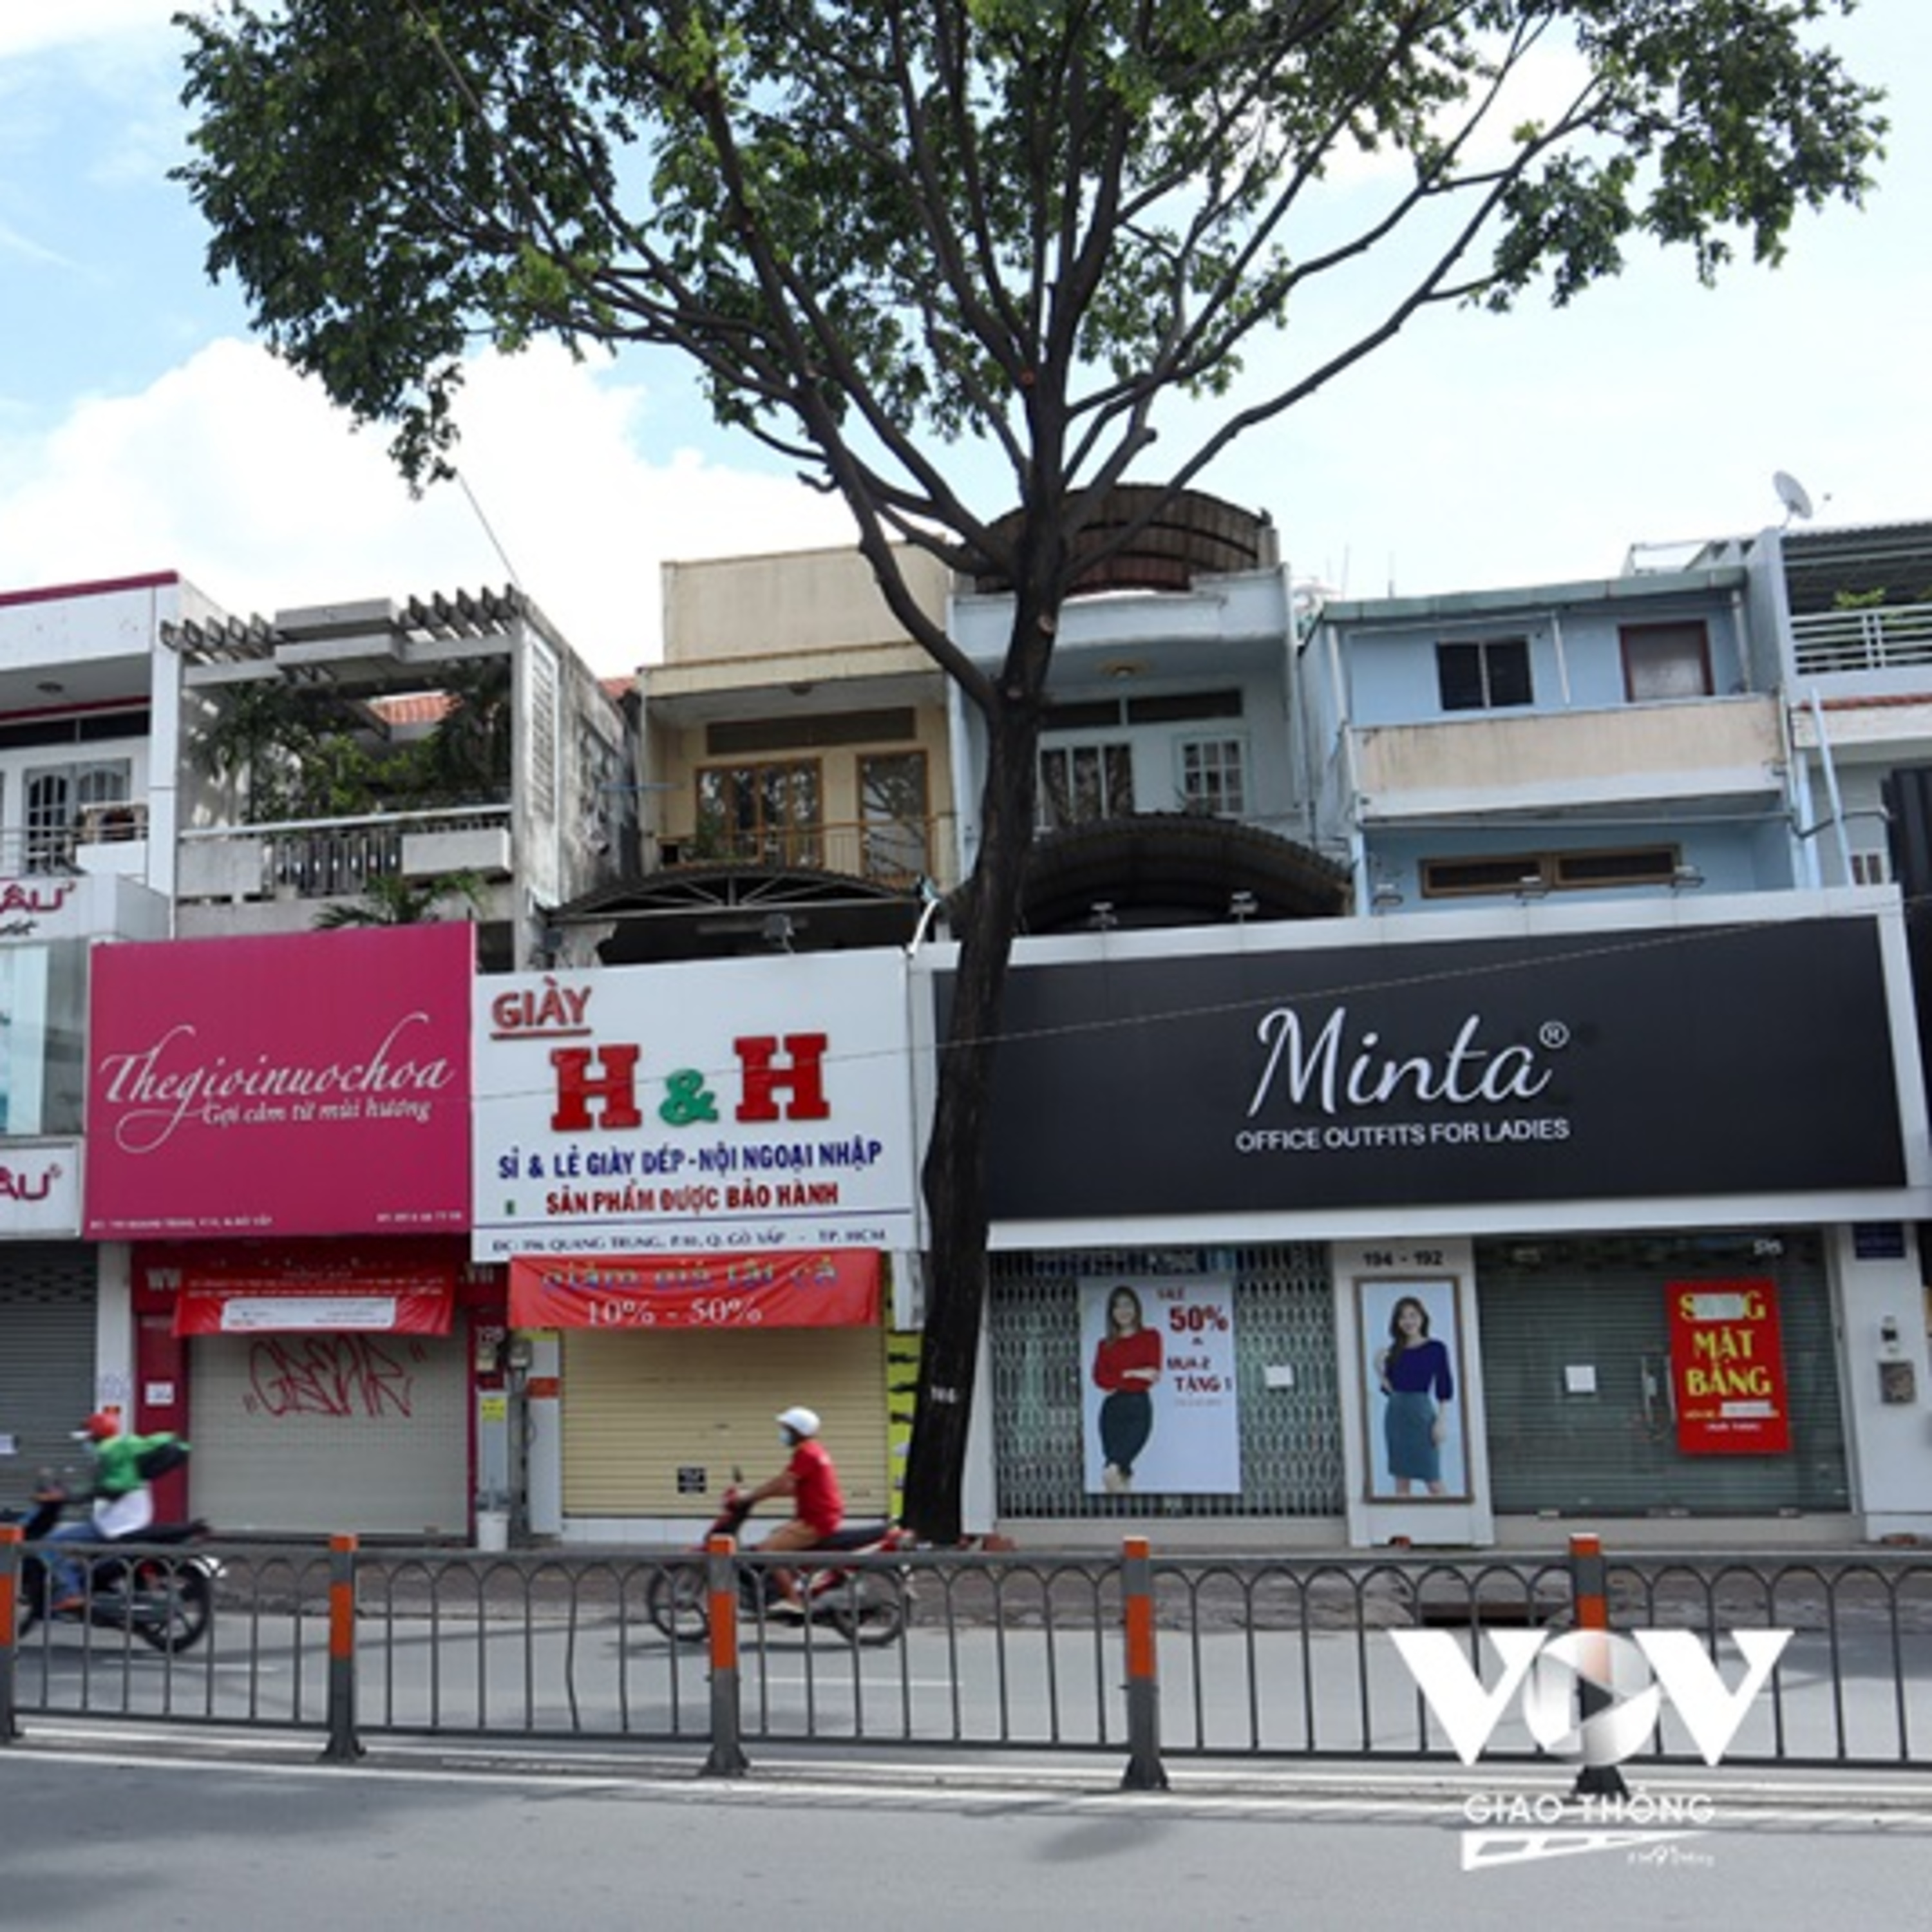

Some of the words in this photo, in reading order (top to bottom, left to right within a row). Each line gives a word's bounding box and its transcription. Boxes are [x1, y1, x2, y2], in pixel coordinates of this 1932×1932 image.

[492, 976, 592, 1029] GIÀY
[99, 1012, 455, 1153] Thegioinuochoa
[551, 1044, 642, 1132] H
[659, 1068, 718, 1126] &
[734, 1033, 831, 1122] H
[1235, 1128, 1320, 1152] OFFICE
[1323, 1123, 1426, 1148] OUTFITS
[1430, 1121, 1480, 1144] FOR
[1482, 1117, 1570, 1143] LADIES
[528, 1153, 544, 1179] &
[587, 1146, 634, 1176] GIÀY
[743, 1143, 813, 1173] NGOẠI
[819, 1134, 883, 1171] NHẬP
[547, 1184, 588, 1215] SẢN
[726, 1177, 771, 1209] BẢO
[777, 1178, 838, 1208] HÀNH
[587, 1299, 656, 1325] 10%
[688, 1296, 762, 1324] 50%
[1169, 1303, 1229, 1332] 50%
[1680, 1291, 1766, 1321] SG
[1693, 1325, 1754, 1364] MẶT
